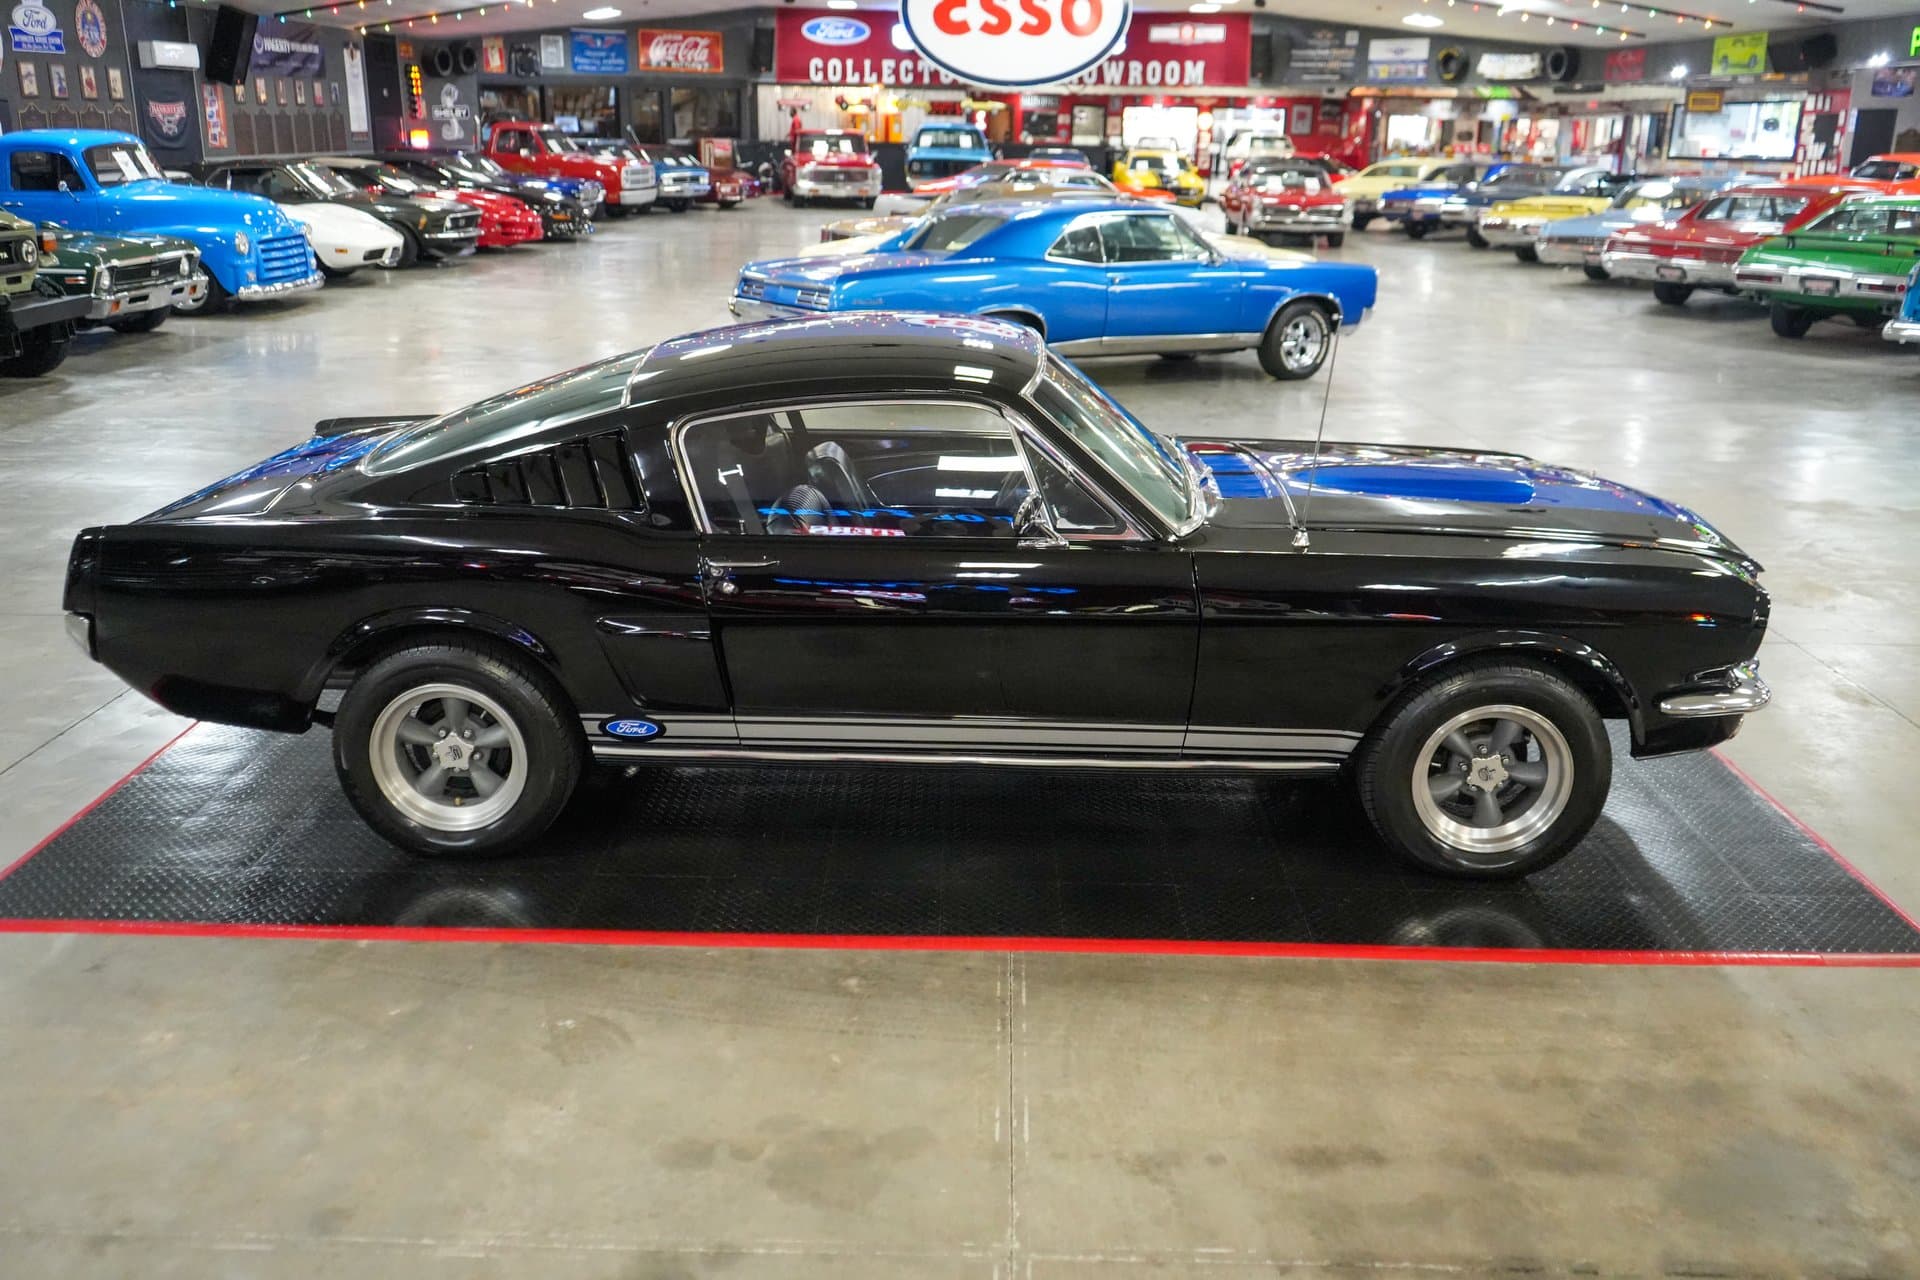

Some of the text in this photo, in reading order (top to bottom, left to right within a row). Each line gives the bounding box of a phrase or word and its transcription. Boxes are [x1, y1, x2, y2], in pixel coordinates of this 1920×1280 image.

[22, 9, 48, 29] Ford
[815, 21, 857, 40] Ford
[616, 721, 648, 734] Ford
